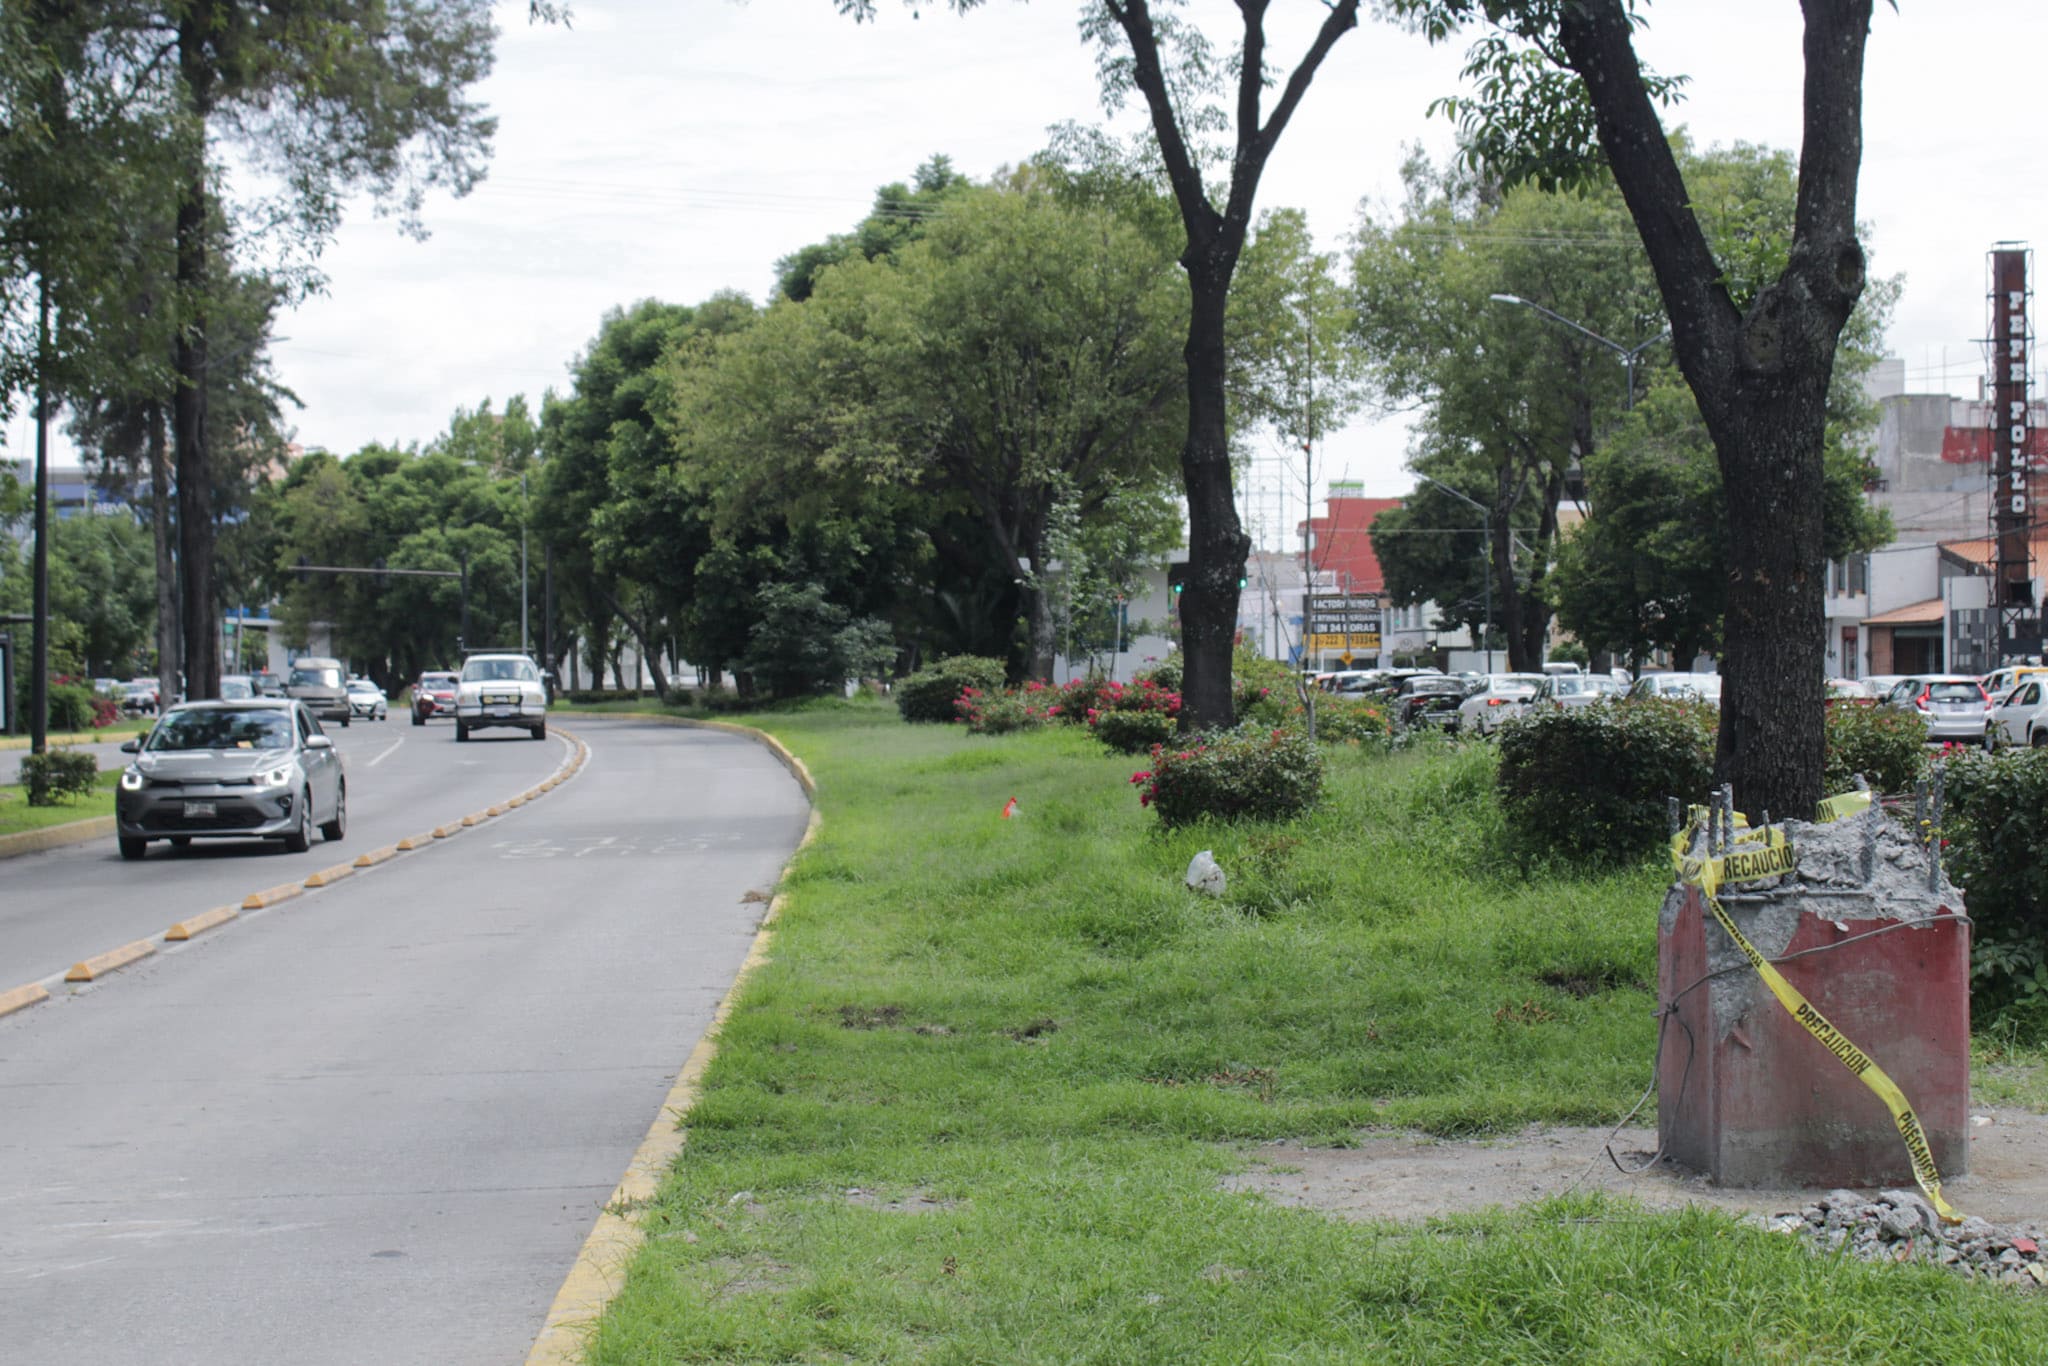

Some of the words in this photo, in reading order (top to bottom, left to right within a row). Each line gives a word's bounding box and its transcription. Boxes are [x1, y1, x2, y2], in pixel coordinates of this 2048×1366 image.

[2009, 290, 2025, 382] PEPE
[2010, 401, 2026, 513] POLLO
[1330, 623, 1342, 633] 24
[1796, 1003, 1871, 1075] PRECAUCION
